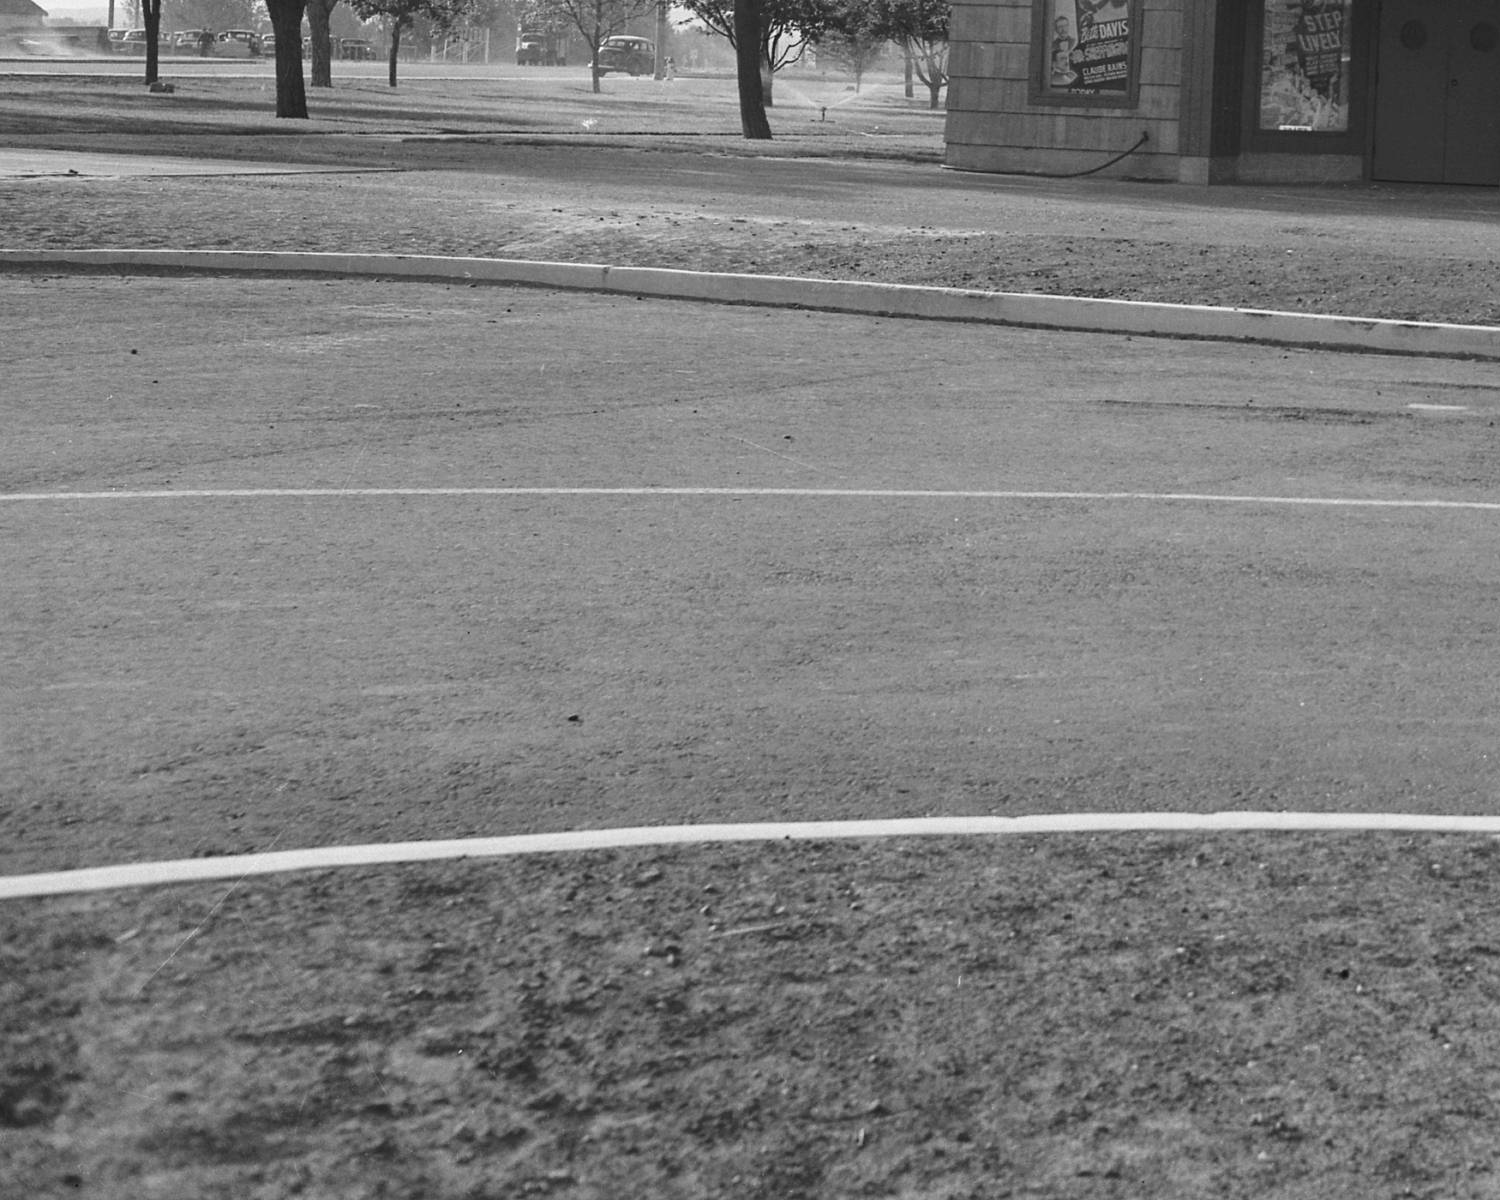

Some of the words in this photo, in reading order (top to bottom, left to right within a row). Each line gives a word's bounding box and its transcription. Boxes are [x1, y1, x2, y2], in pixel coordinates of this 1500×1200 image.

[1099, 20, 1129, 39] DAVIS
[1303, 10, 1342, 32] STEP
[1298, 30, 1341, 52] LIVELY
